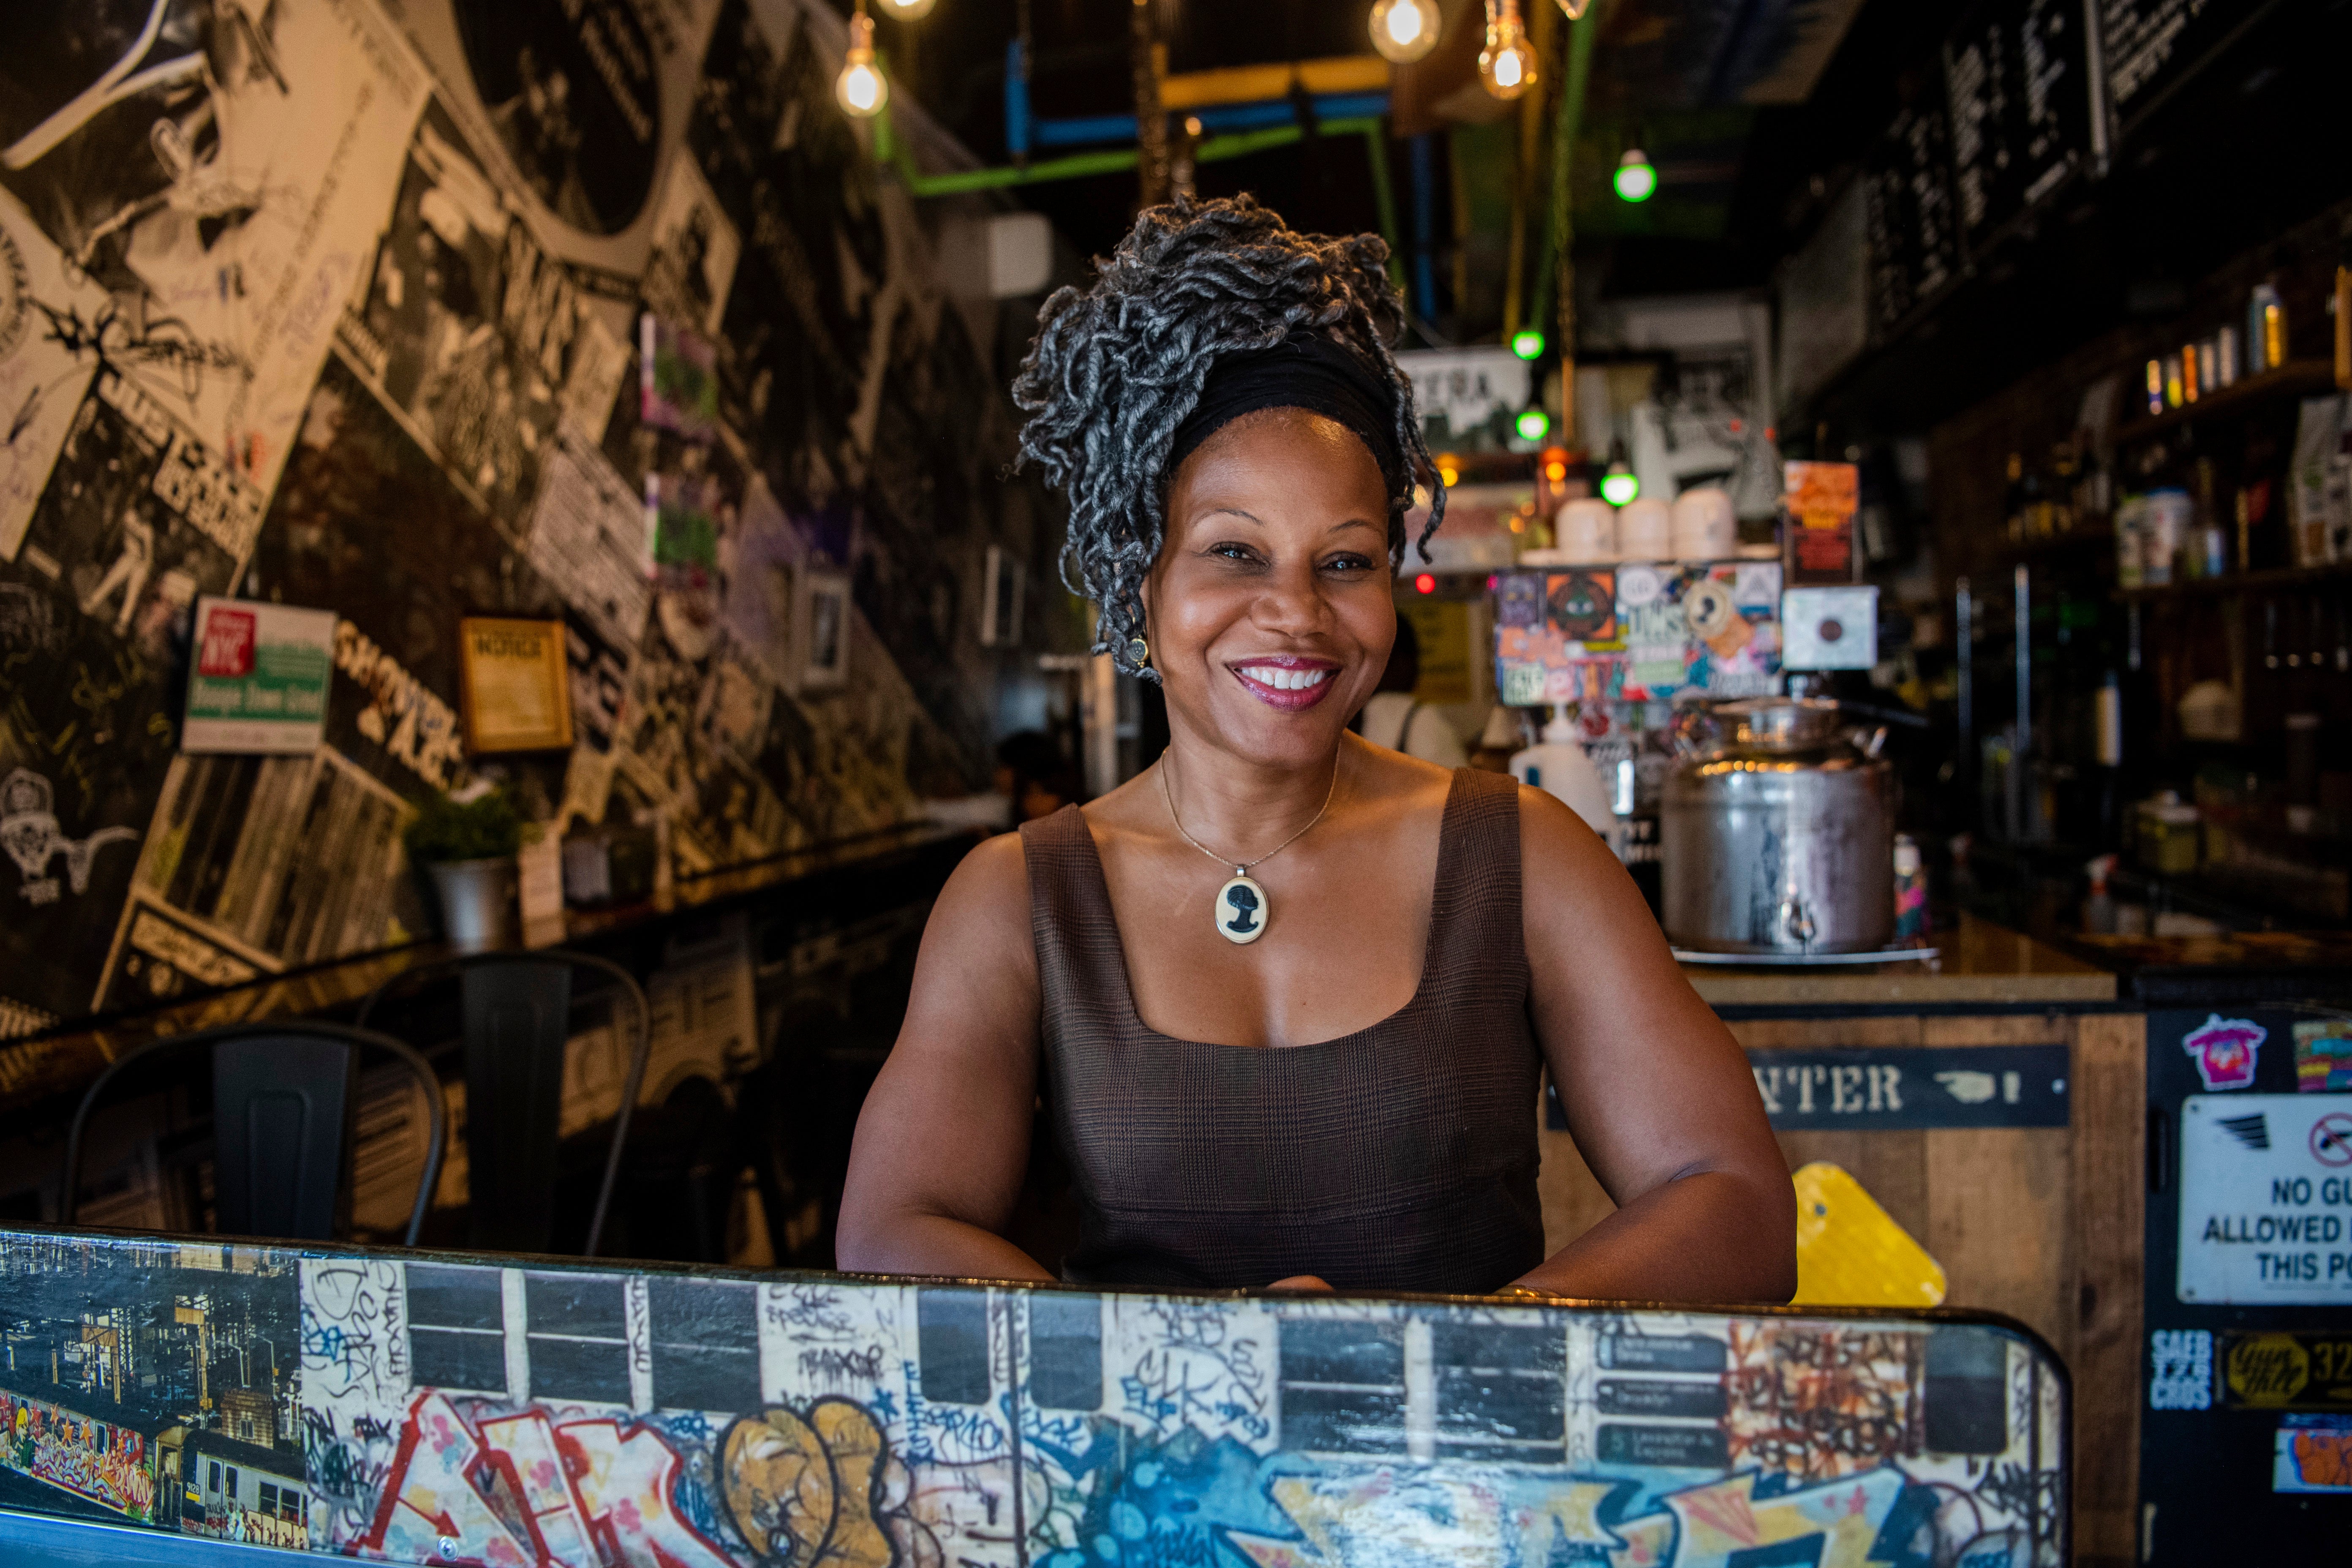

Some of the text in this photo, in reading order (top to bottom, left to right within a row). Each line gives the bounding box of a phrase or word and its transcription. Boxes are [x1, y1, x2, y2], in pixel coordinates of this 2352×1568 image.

[2271, 1177, 2312, 1206] NO
[2203, 1215, 2341, 1243] ALLOWED
[2256, 1252, 2352, 1280] THIS P
[187, 1481, 200, 1495] 9128
